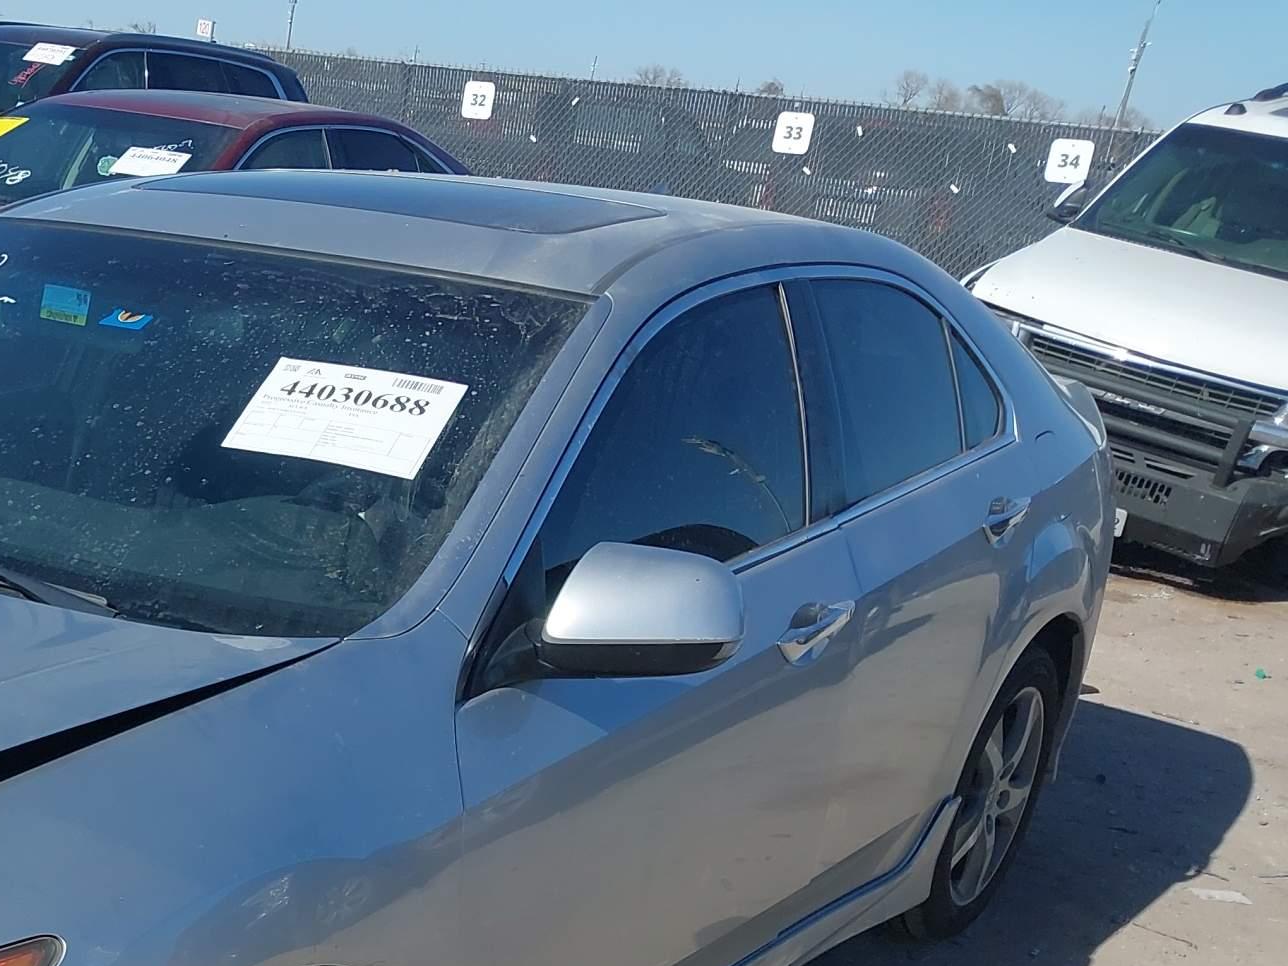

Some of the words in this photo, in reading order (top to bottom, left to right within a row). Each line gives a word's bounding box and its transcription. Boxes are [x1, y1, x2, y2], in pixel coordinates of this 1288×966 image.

[470, 93, 487, 107] 32
[783, 126, 803, 140] 33
[1057, 153, 1081, 169] 34
[279, 379, 431, 417] 44030688
